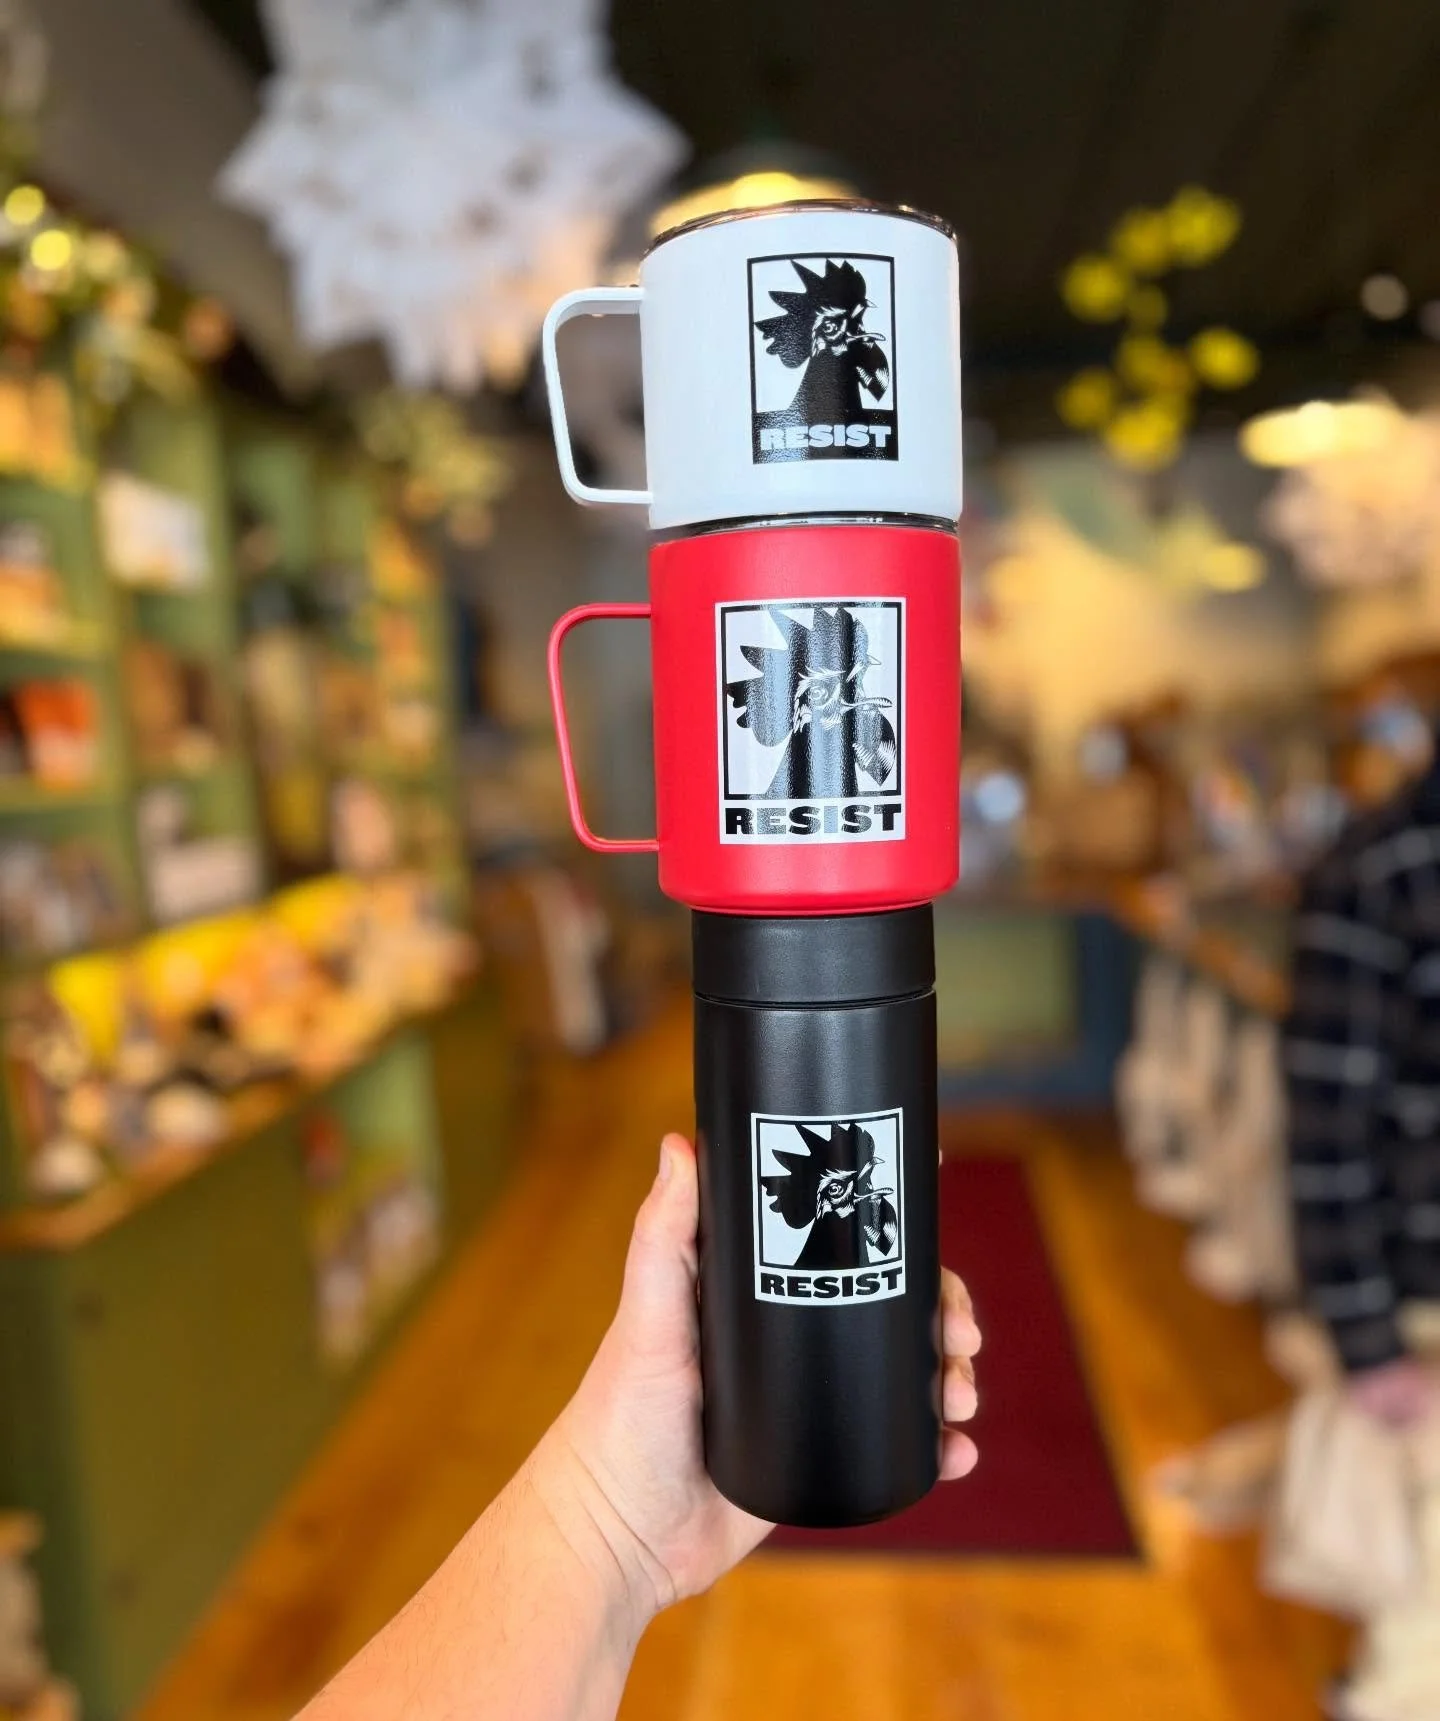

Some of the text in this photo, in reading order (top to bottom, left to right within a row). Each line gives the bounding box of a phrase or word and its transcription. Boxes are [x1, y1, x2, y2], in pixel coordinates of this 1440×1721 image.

[760, 424, 892, 450] RESIST
[725, 804, 902, 835] RESIST
[760, 1267, 903, 1299] RESIST
